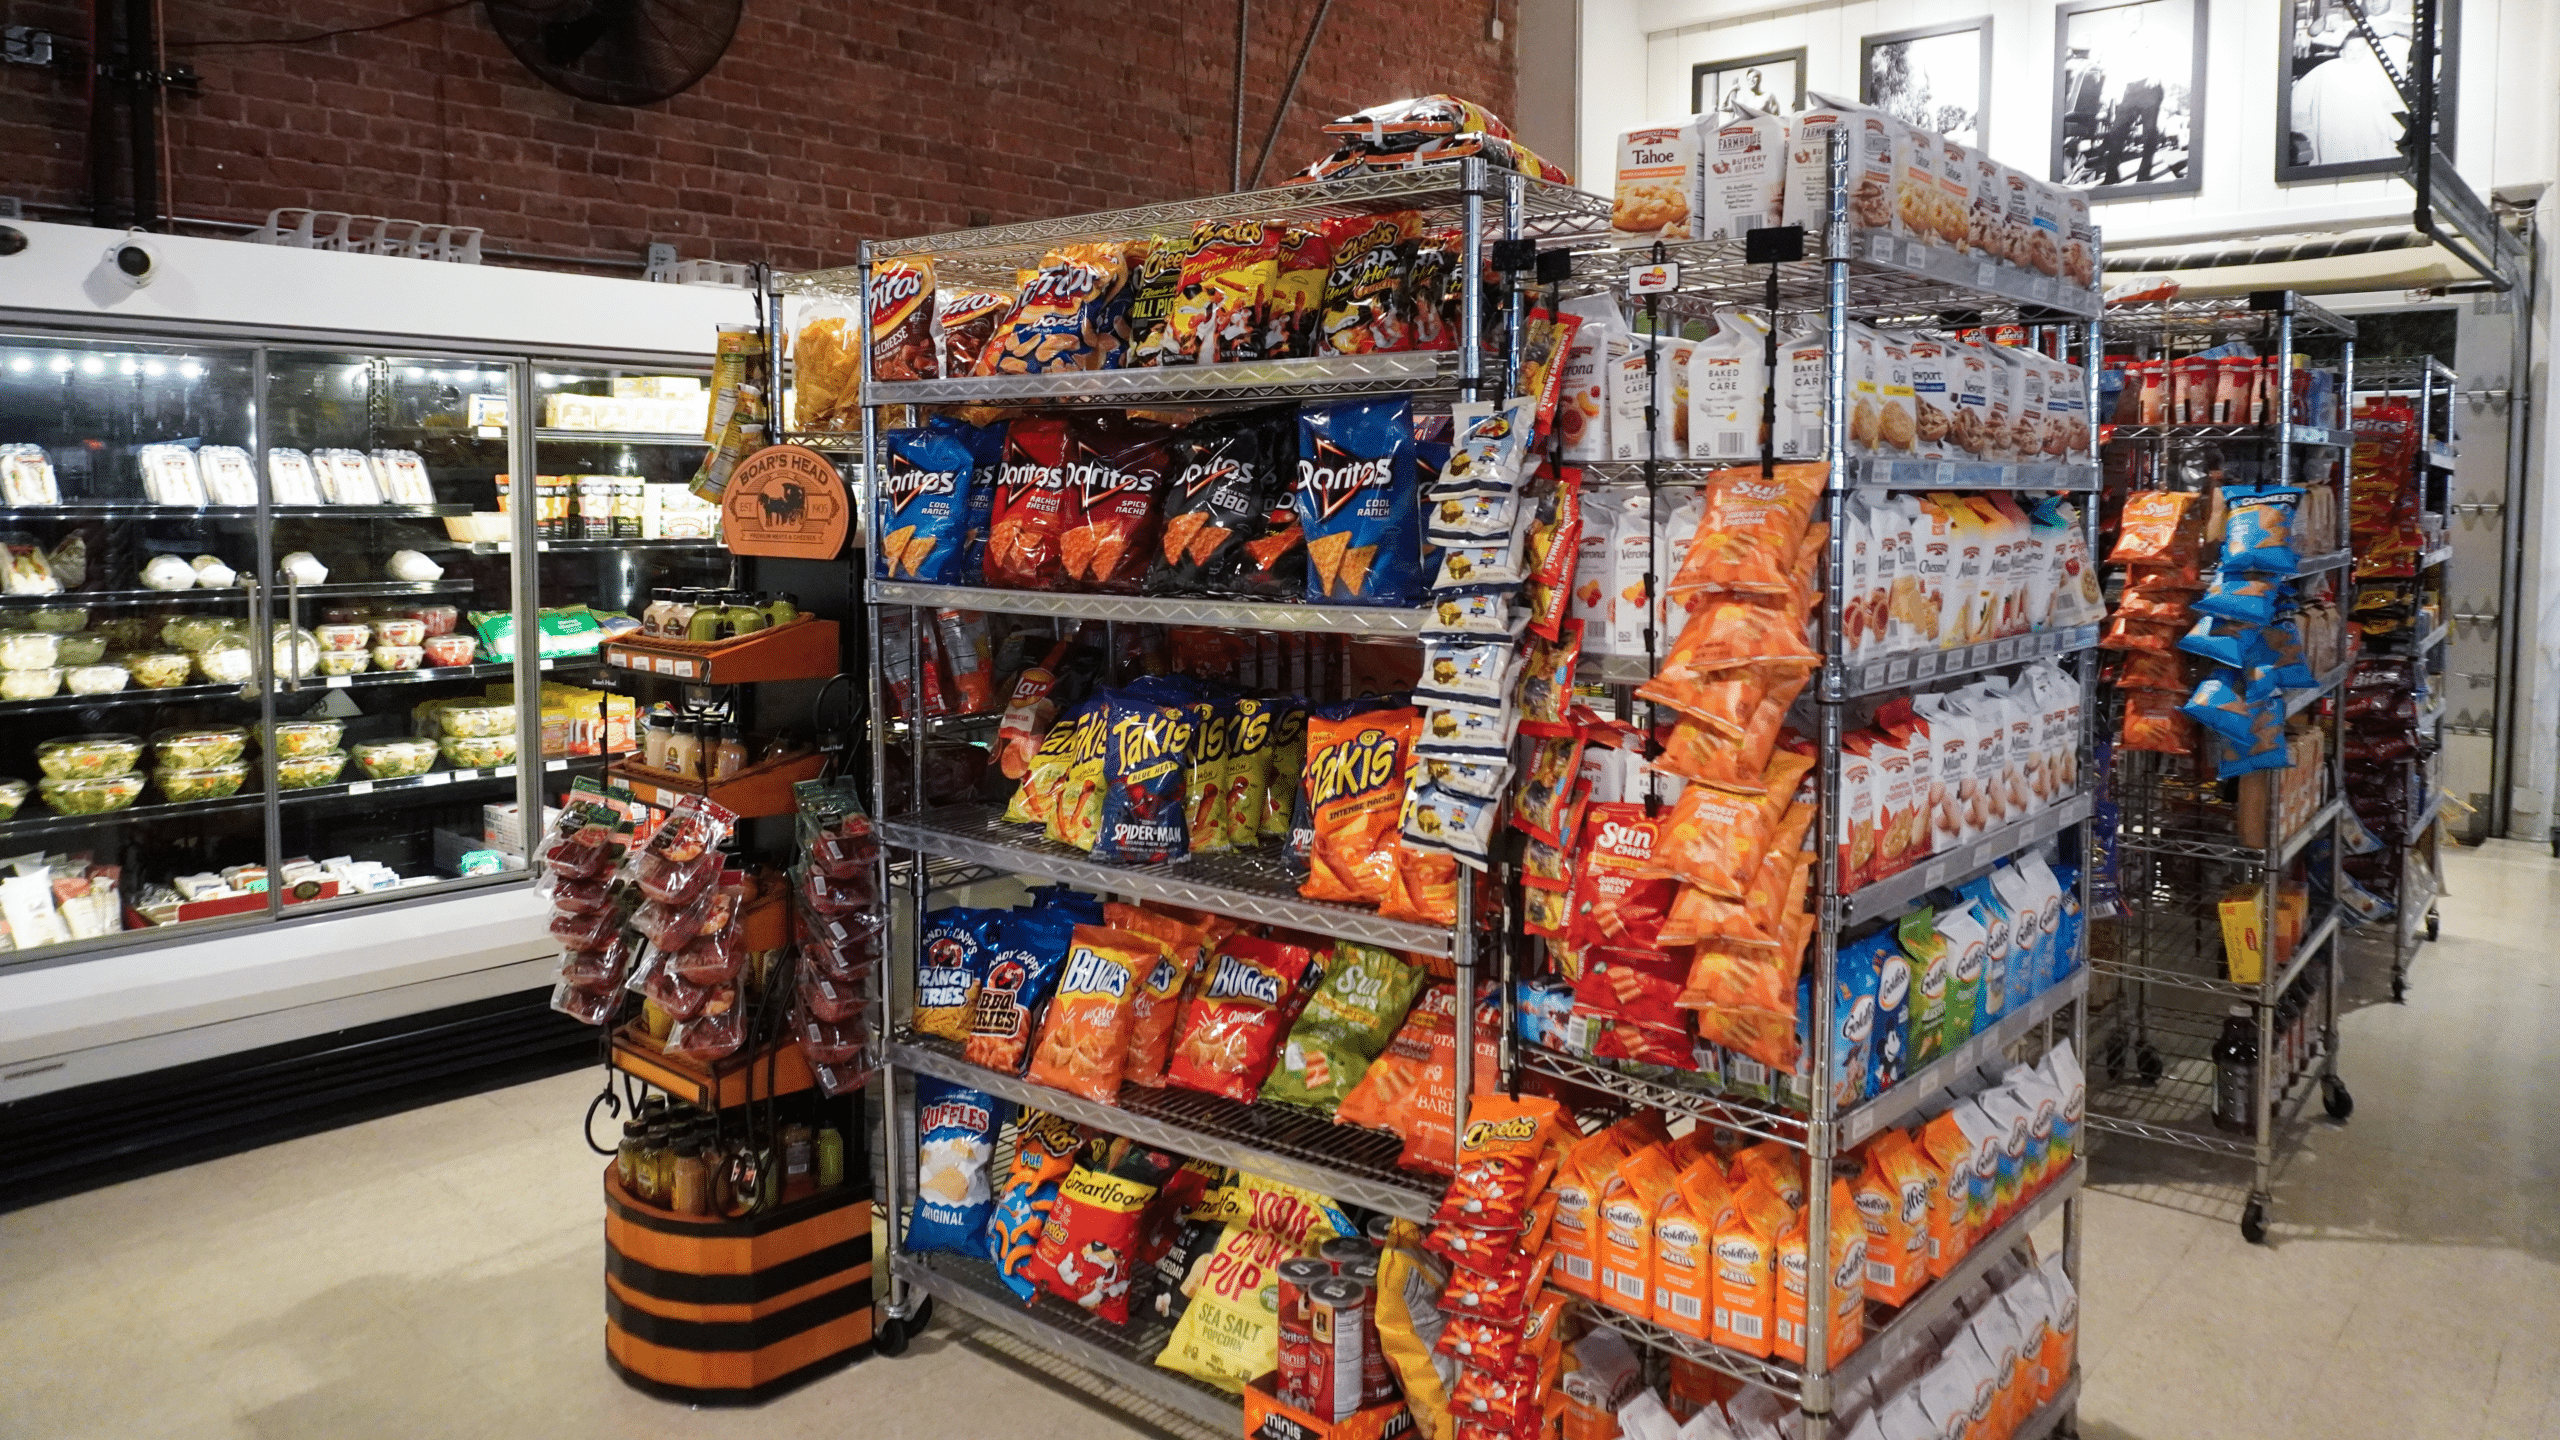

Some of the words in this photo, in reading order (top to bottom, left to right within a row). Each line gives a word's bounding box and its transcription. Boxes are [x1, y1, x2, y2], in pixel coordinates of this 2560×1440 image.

[1718, 131, 1761, 150] FARMHOUSE
[1632, 149, 1674, 164] Tahoe
[1732, 155, 1767, 166] BUTTERY
[1144, 250, 1186, 282] Chee
[1156, 297, 1175, 316] PIC
[881, 326, 909, 353] CHEESE
[1561, 362, 1595, 378] erona
[1708, 369, 1740, 378] BAKED
[1793, 364, 1820, 373] BAKE
[1912, 370, 1943, 383] ewport
[1625, 383, 1650, 394] CARE
[1709, 382, 1737, 391] CARE
[740, 454, 787, 487] BOAR'S
[792, 454, 829, 487] HEAD
[998, 462, 1064, 489] Doritos
[1066, 462, 1154, 491] Doritos
[1298, 458, 1393, 491] Doritos
[1030, 496, 1057, 505] NACHO
[1115, 506, 1146, 516] NACHO
[1122, 499, 1148, 508] SPICY
[1211, 492, 1250, 513] BBQ
[1366, 499, 1390, 508] COOL
[921, 508, 950, 516] RANCH
[1357, 508, 1390, 517] RANCH
[1131, 770, 1152, 784] BLUE
[1153, 761, 1176, 777] HEAT
[1113, 823, 1182, 844] SPIDER-MAN
[1598, 821, 1652, 849] Sun
[1613, 843, 1652, 860] CHIPS
[922, 928, 949, 946] ANDY
[952, 927, 978, 958] CAPP'S
[988, 949, 1017, 969] ANDY
[1017, 949, 1043, 981] CAPP'S
[918, 968, 971, 989] RANCH
[1336, 965, 1382, 997] Sun
[919, 986, 967, 1007] FRIES
[980, 992, 1016, 1010] BBQ
[921, 1103, 989, 1134] RUFFLES
[1467, 1119, 1536, 1148] Cheetos
[1065, 1170, 1152, 1206] Smartfood
[921, 1204, 965, 1226] ORIGINAL
[1605, 1207, 1644, 1228] Goldfish
[1658, 1227, 1700, 1245] Goldfish
[1716, 1244, 1760, 1265] Goldfish
[1781, 1252, 1808, 1270] Gold
[1202, 1252, 1262, 1303] POP
[1198, 1303, 1221, 1329] SEA
[1223, 1313, 1263, 1343] SALT
[1203, 1325, 1244, 1351] POPCORN
[1265, 1412, 1302, 1440] minis
